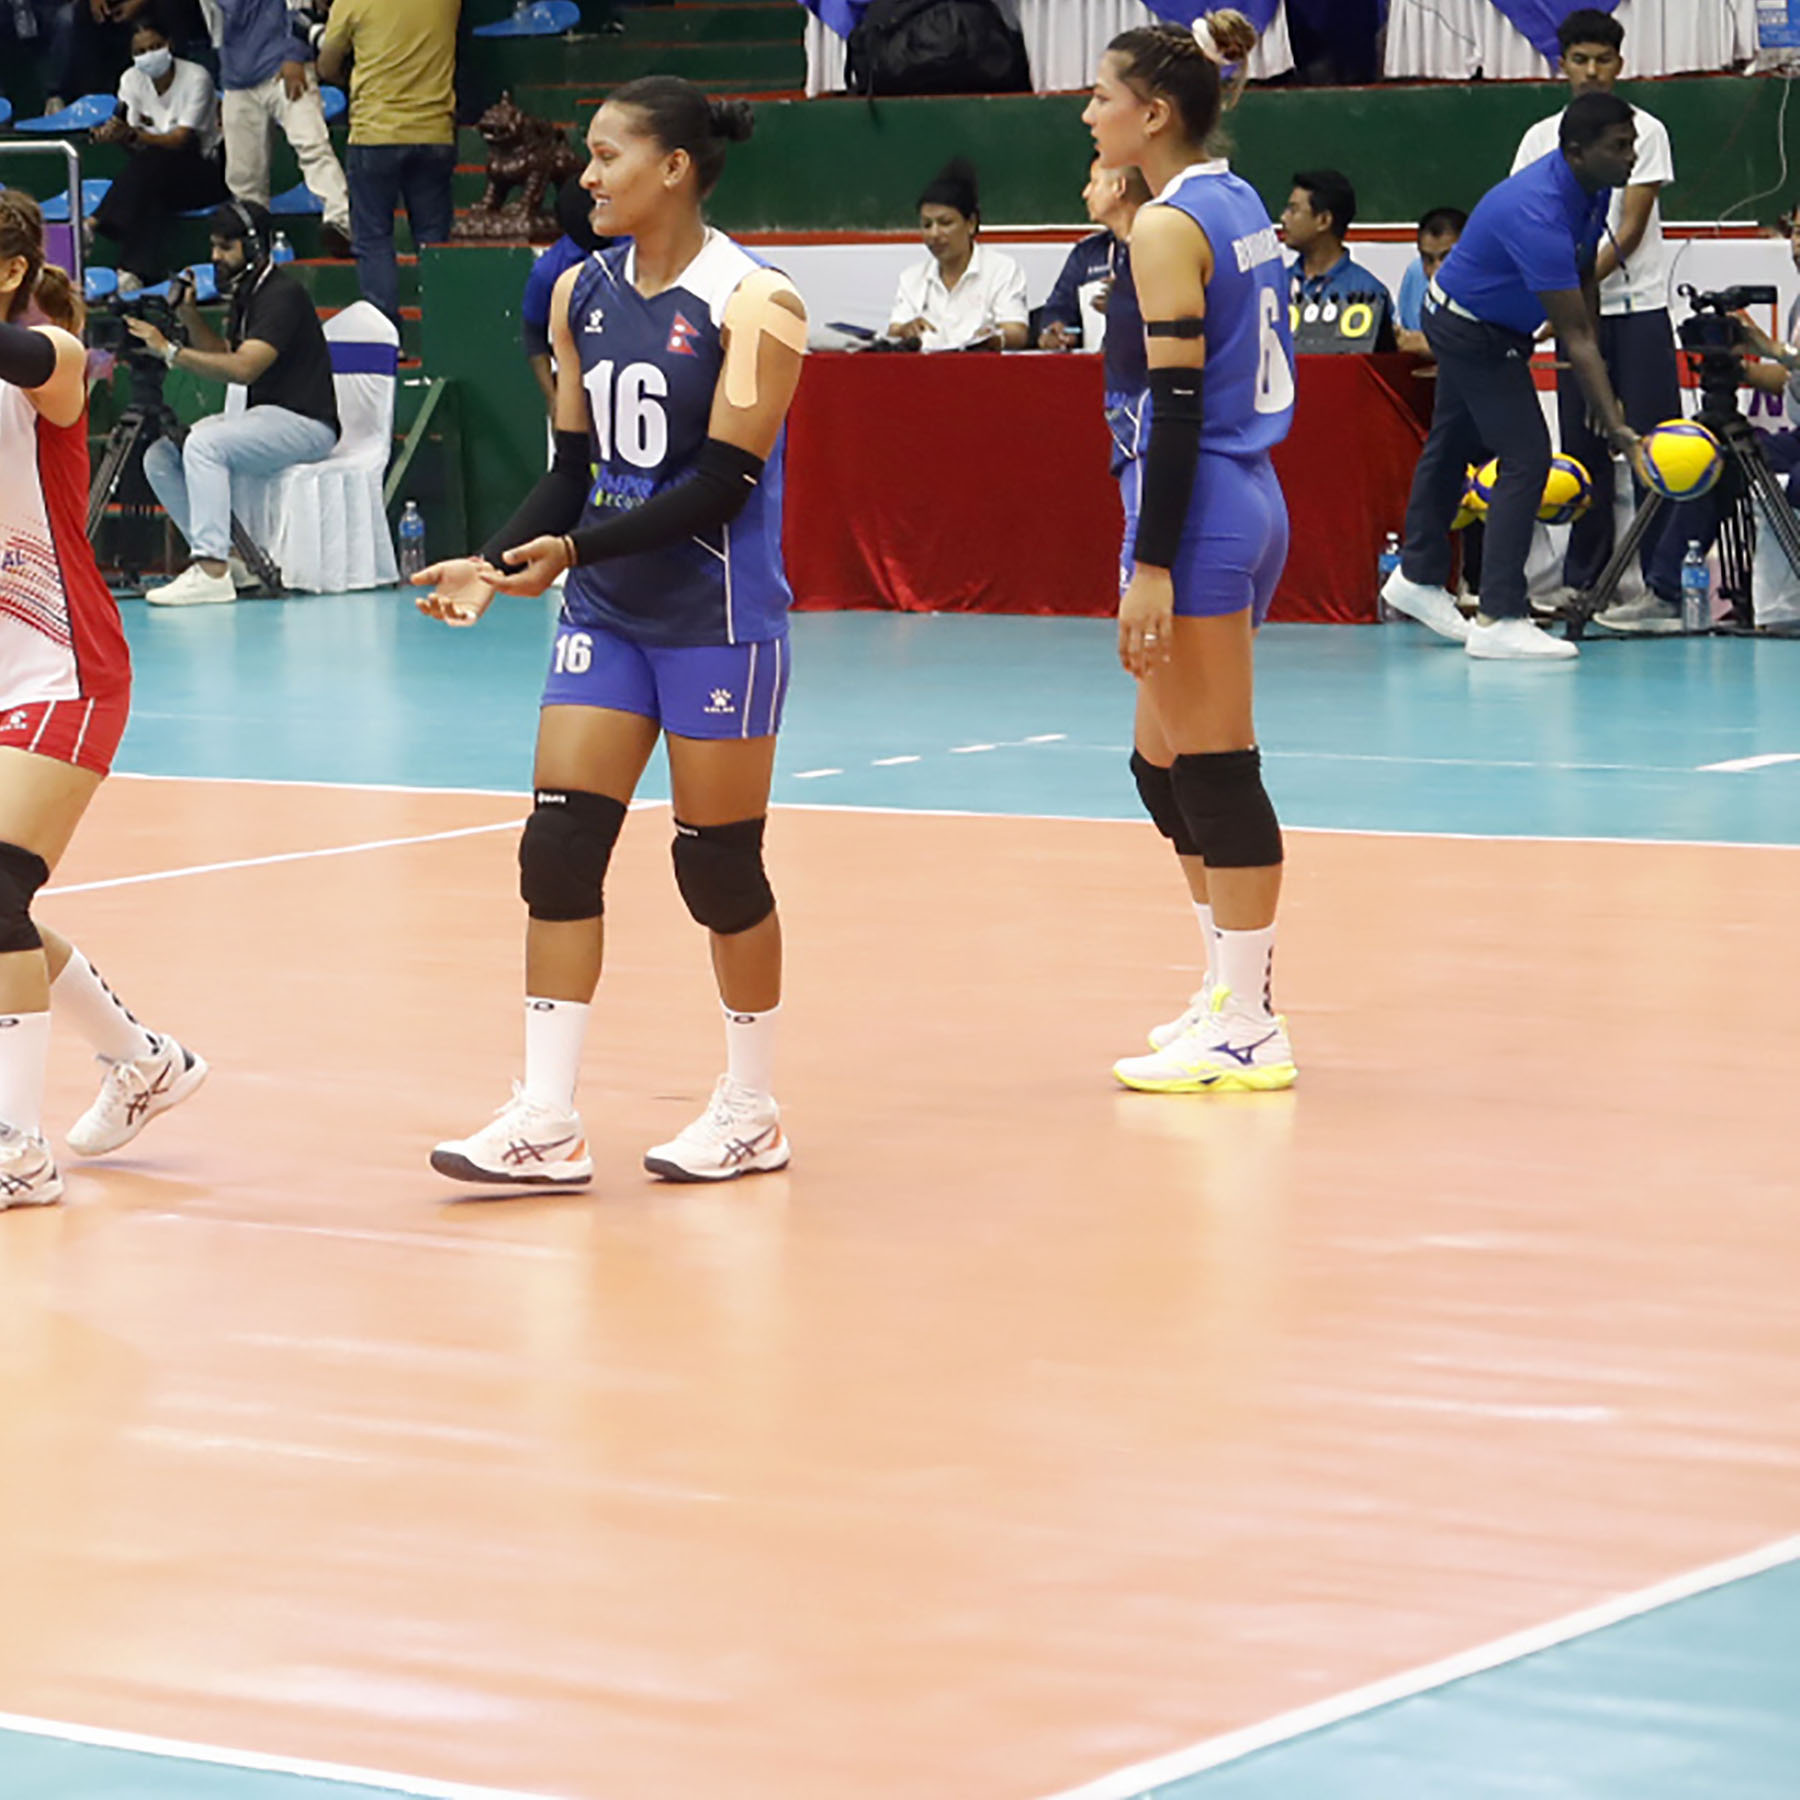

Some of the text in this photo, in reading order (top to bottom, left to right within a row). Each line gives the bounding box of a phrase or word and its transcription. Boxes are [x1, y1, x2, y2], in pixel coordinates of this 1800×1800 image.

[1340, 303, 1373, 338] 0
[583, 360, 668, 468] 16
[554, 631, 594, 674] 16
